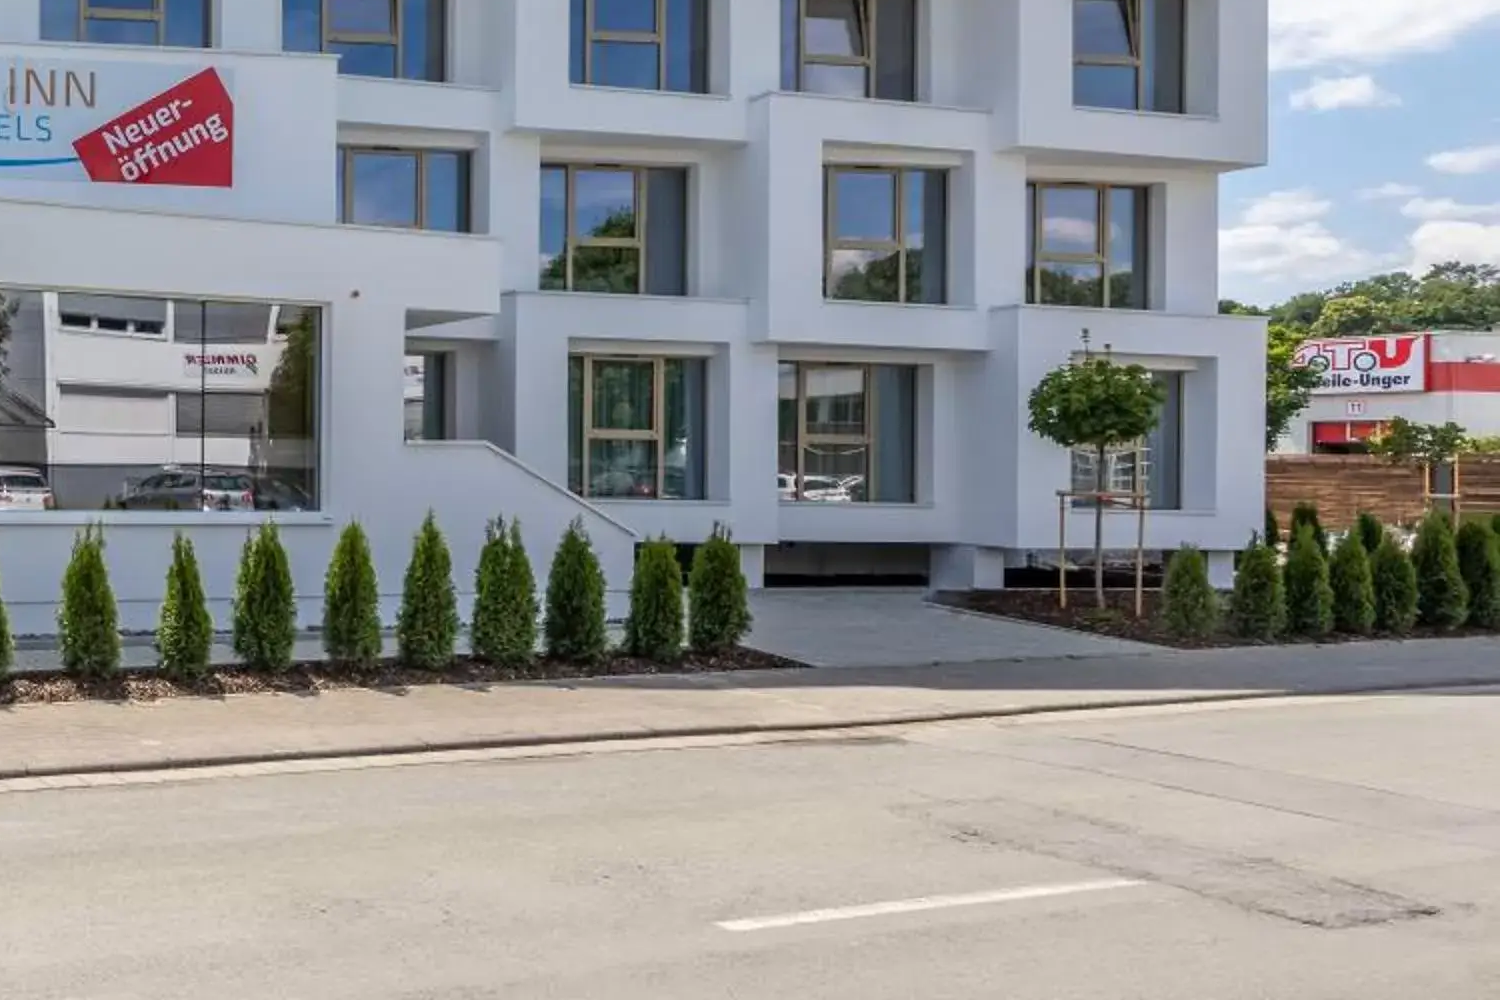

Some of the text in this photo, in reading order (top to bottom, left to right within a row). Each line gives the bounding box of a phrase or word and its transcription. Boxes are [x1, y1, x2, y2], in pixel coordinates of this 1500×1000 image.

[8, 67, 95, 108] INN
[102, 99, 192, 154] Neuer-
[118, 113, 229, 181] öffnung
